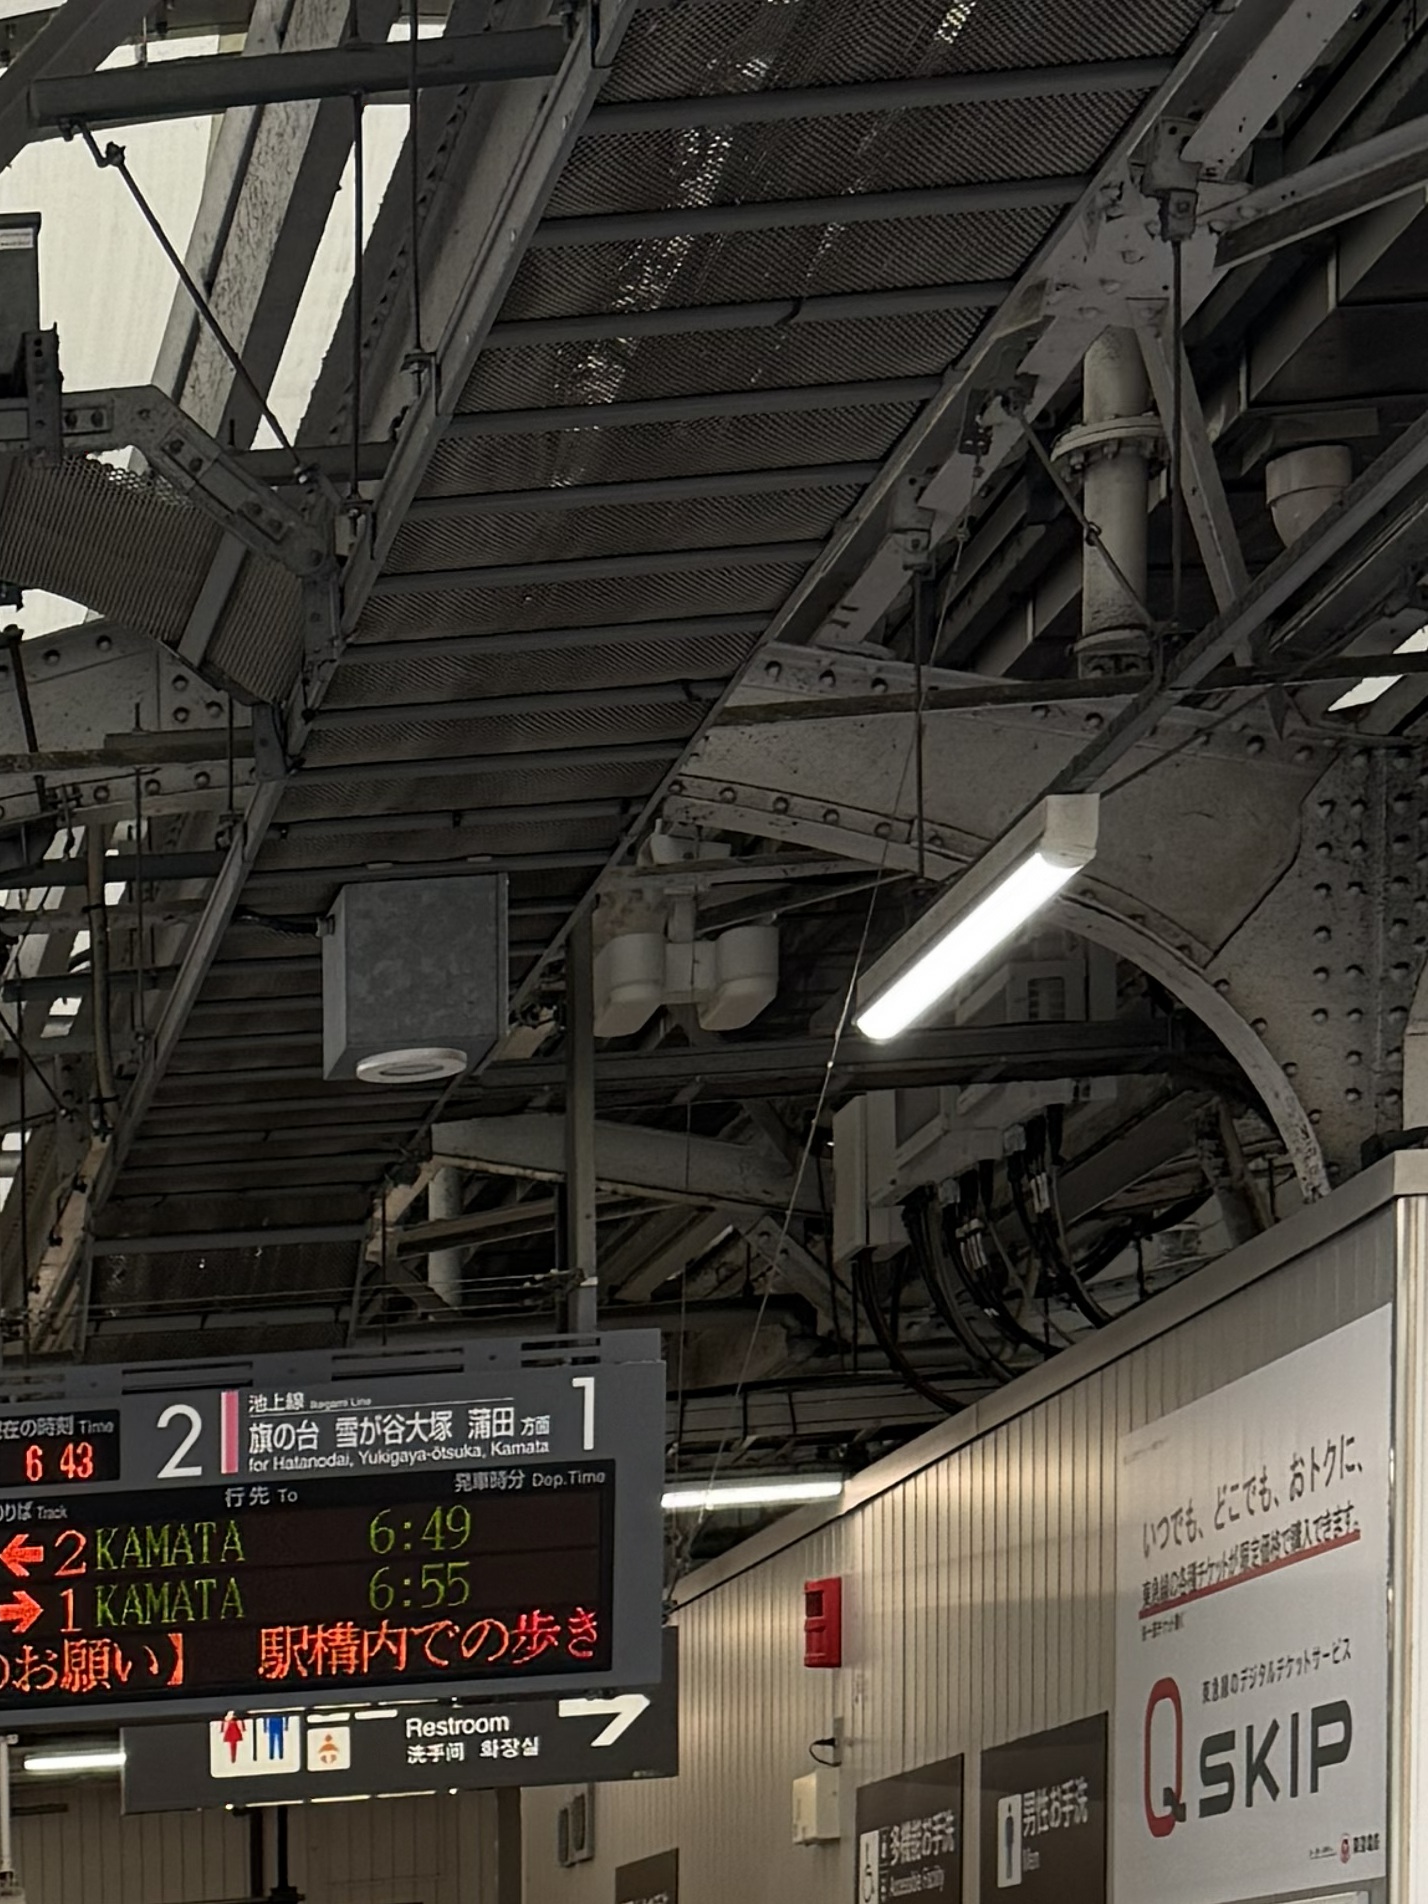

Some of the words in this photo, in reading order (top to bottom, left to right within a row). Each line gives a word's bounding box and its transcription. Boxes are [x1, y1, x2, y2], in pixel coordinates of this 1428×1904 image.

[248, 1391, 305, 1414] 池上線
[571, 1376, 596, 1451] 1
[79, 1419, 115, 1434] Time
[157, 1403, 203, 1480] 2
[248, 1420, 320, 1455] 旗の台
[335, 1409, 453, 1450] 雪が谷大塚
[467, 1407, 515, 1439] 蒲田
[520, 1415, 550, 1437] 方面
[248, 1455, 269, 1473] for
[490, 1439, 550, 1457] Kamata
[224, 1486, 270, 1508] 行先
[277, 1488, 299, 1503] To
[453, 1469, 526, 1493] 発車時分
[36, 1505, 68, 1521] Track
[54, 1529, 88, 1578] 2
[95, 1520, 246, 1571] KAMATA
[368, 1504, 472, 1555] 6:49
[58, 1587, 83, 1633] 1
[95, 1577, 246, 1627] KAMATA
[368, 1560, 472, 1611] 6:55
[256, 1604, 600, 1681] 駅構内での歩き
[1201, 1637, 1352, 1705] 東急線のデジタルチケットサービス
[405, 1712, 511, 1739] Restroom
[479, 1735, 541, 1760] 화장실
[1199, 1698, 1353, 1819] SKIP
